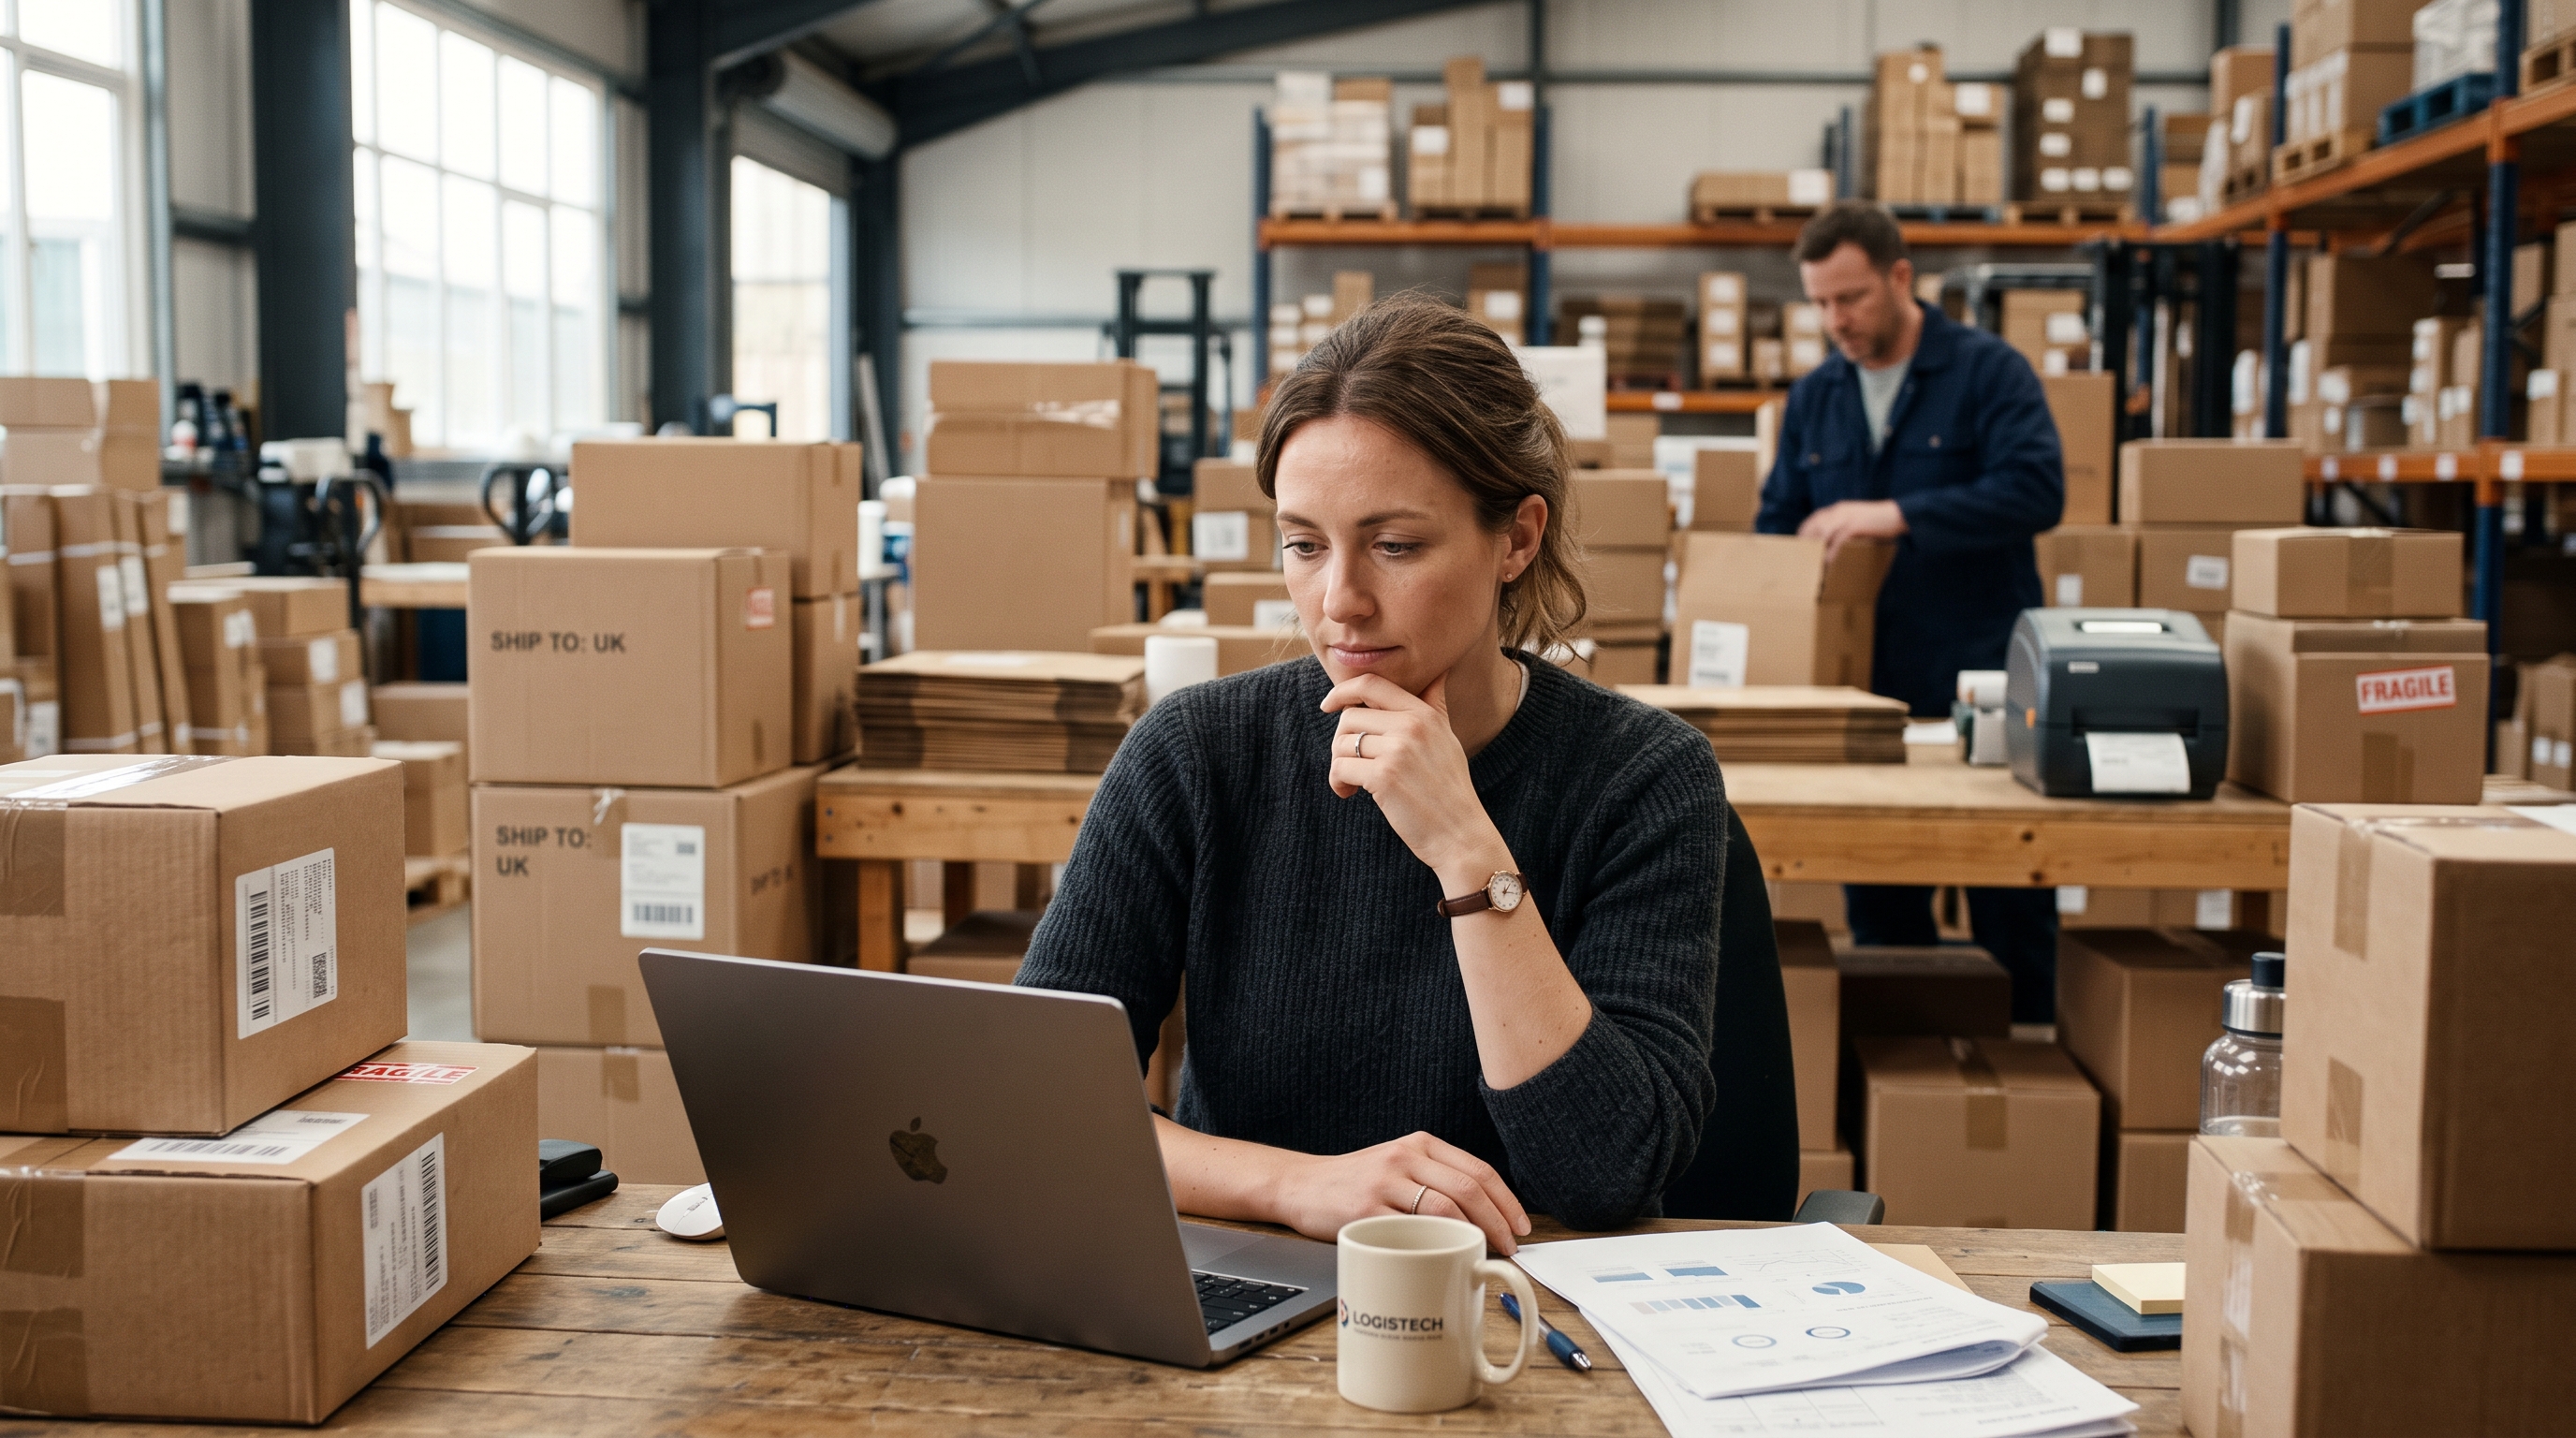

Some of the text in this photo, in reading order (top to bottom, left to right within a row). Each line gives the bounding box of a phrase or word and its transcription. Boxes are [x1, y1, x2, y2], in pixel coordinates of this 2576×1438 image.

[490, 630, 626, 653] SHIP TO: UK
[2362, 674, 2449, 702] FRAGILE
[496, 825, 593, 849] SHIP TO:
[496, 856, 529, 876] UK
[347, 1066, 468, 1079] RAGILE
[1353, 1311, 1443, 1331] LOGISTECH
